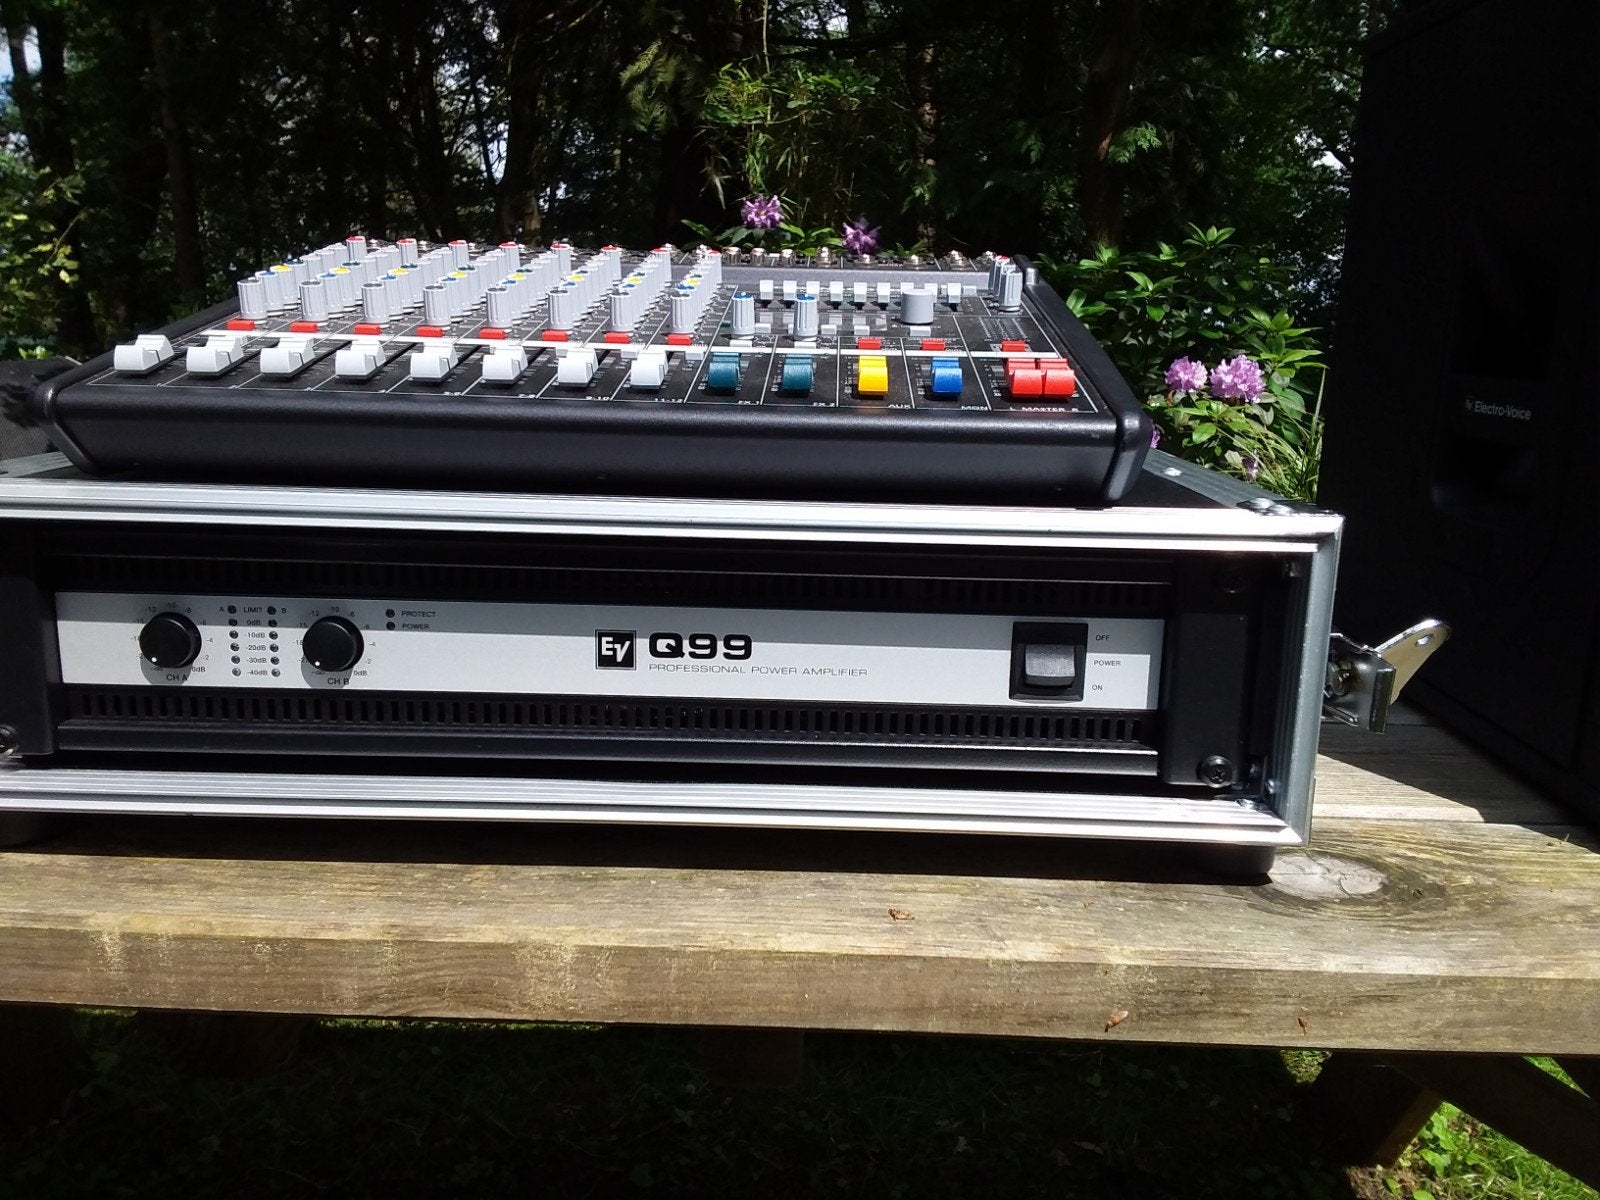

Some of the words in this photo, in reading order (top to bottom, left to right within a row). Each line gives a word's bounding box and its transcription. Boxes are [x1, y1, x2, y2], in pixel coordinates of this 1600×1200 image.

[1474, 400, 1532, 420] Electro-Voice
[601, 636, 631, 662] EV
[649, 632, 752, 660] Q99
[649, 664, 746, 674] PROFESSIONAL
[751, 666, 797, 675] POWER
[801, 668, 868, 677] AMPLIFIER
